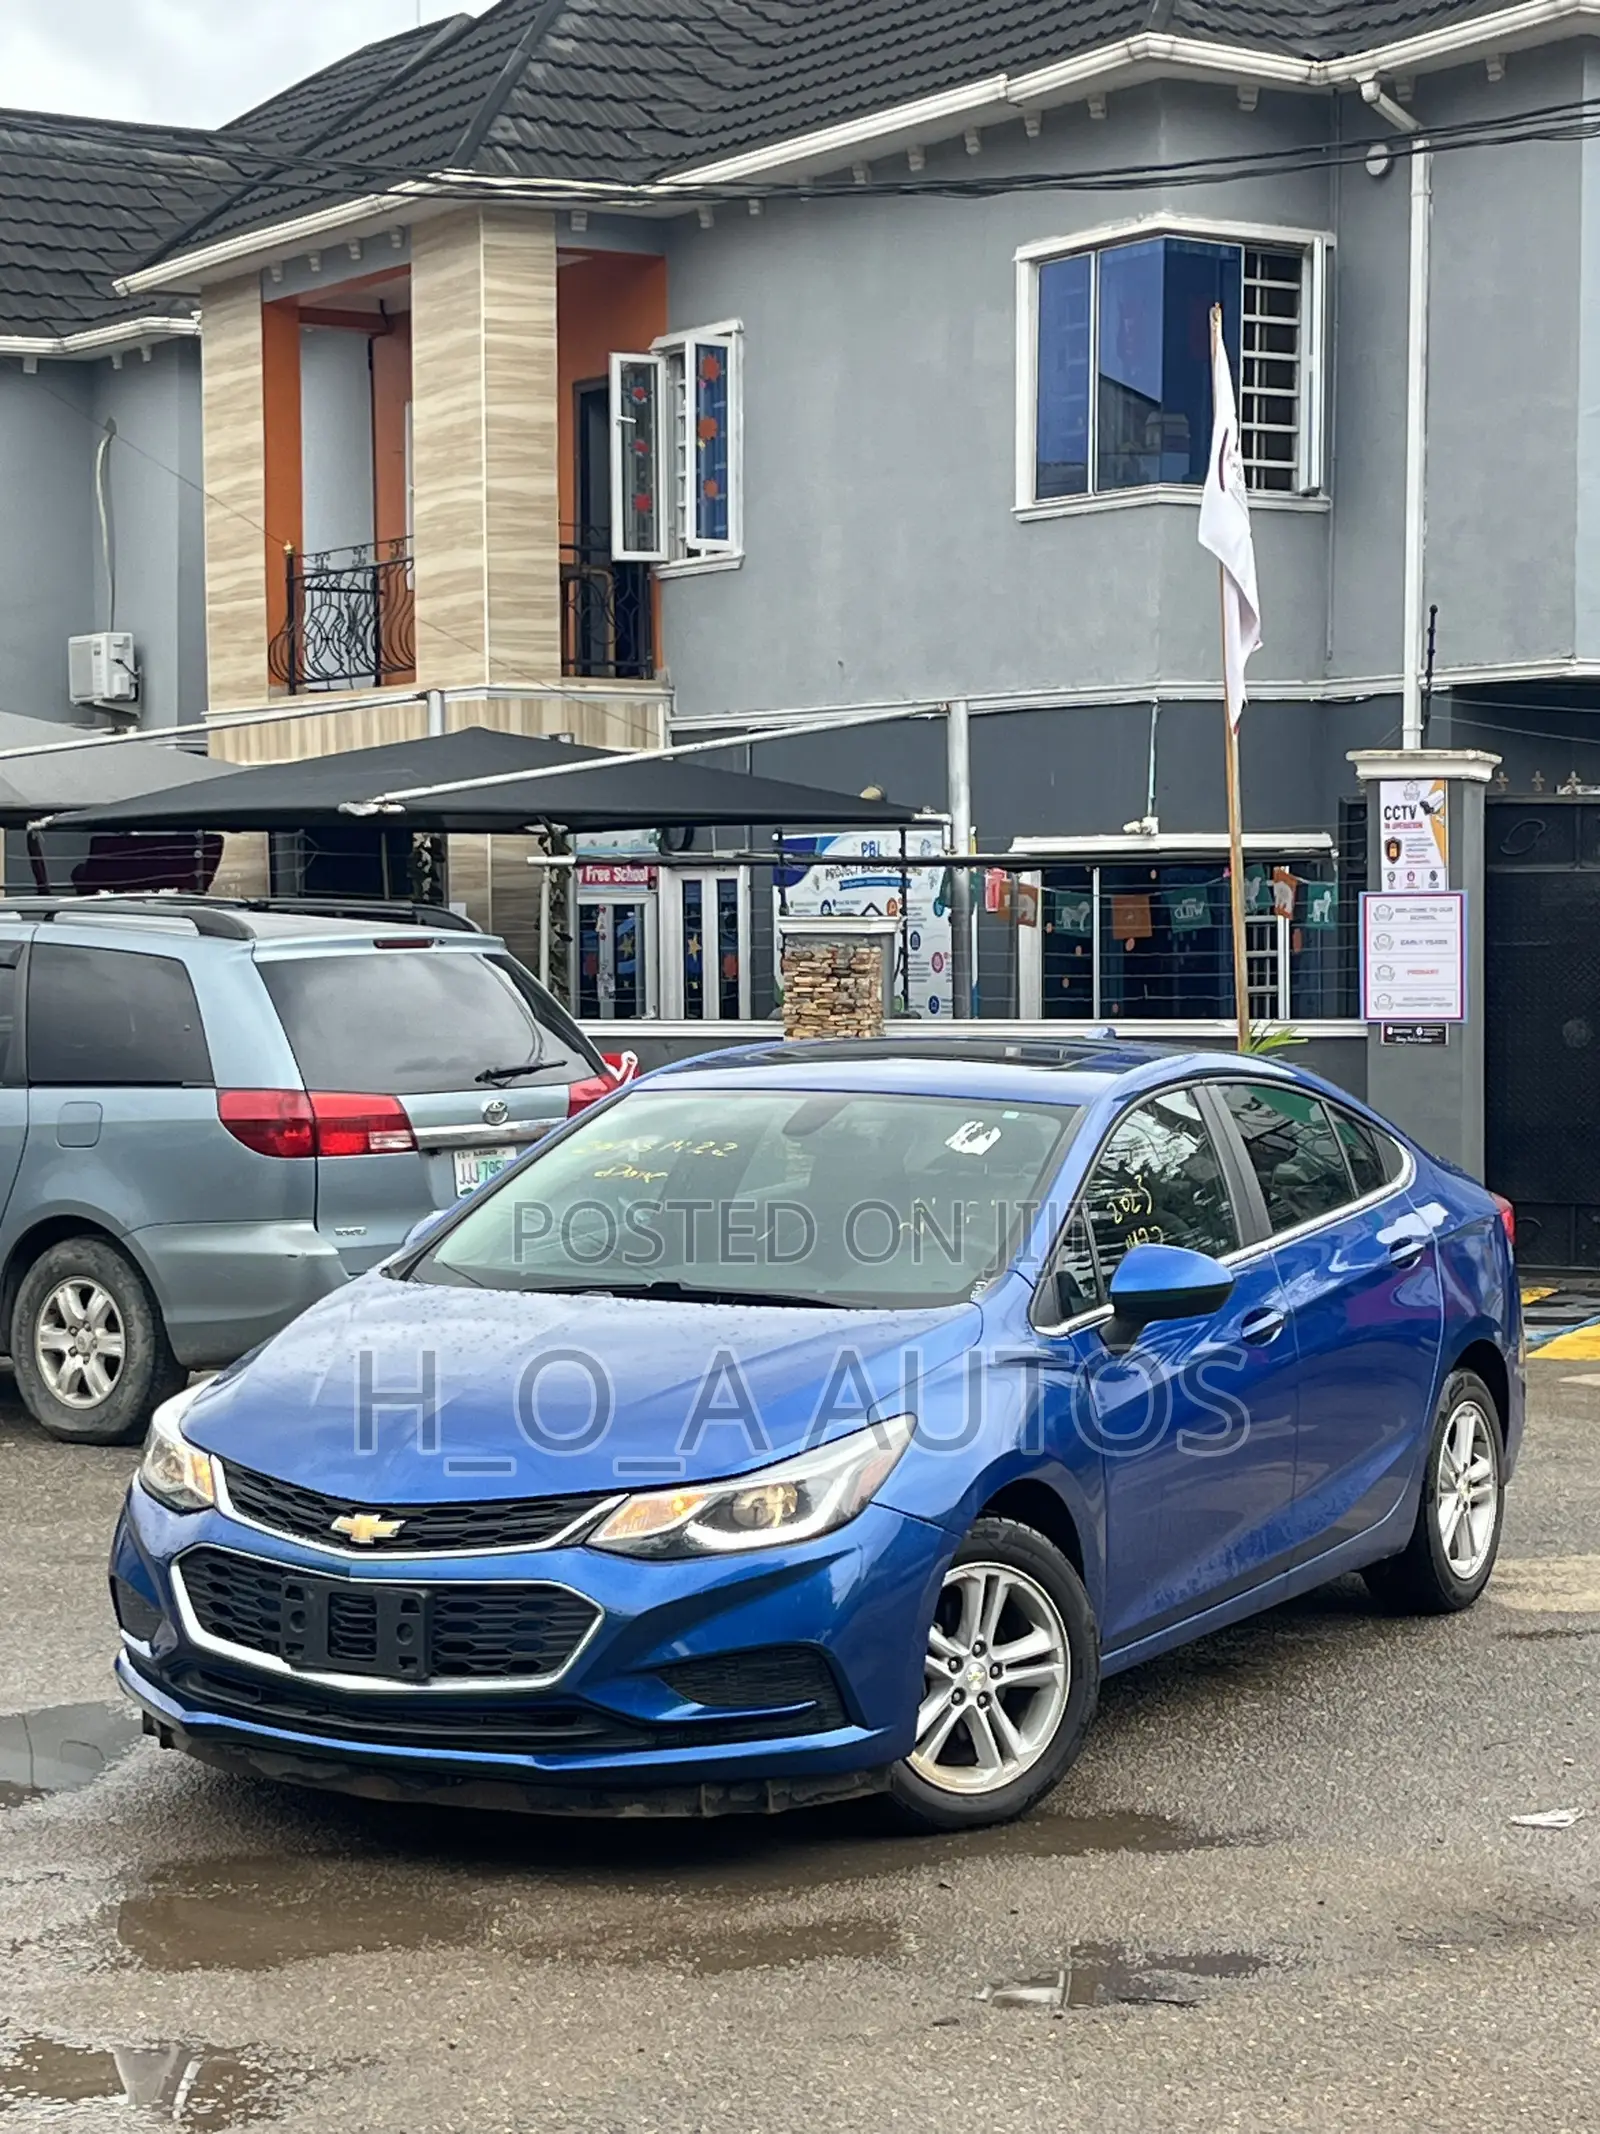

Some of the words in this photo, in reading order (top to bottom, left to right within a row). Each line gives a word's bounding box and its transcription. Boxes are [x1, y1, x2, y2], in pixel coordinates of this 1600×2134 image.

[1384, 804, 1417, 820] CCTV
[861, 840, 882, 857] PBL
[586, 865, 611, 882] Free
[613, 864, 649, 882] School
